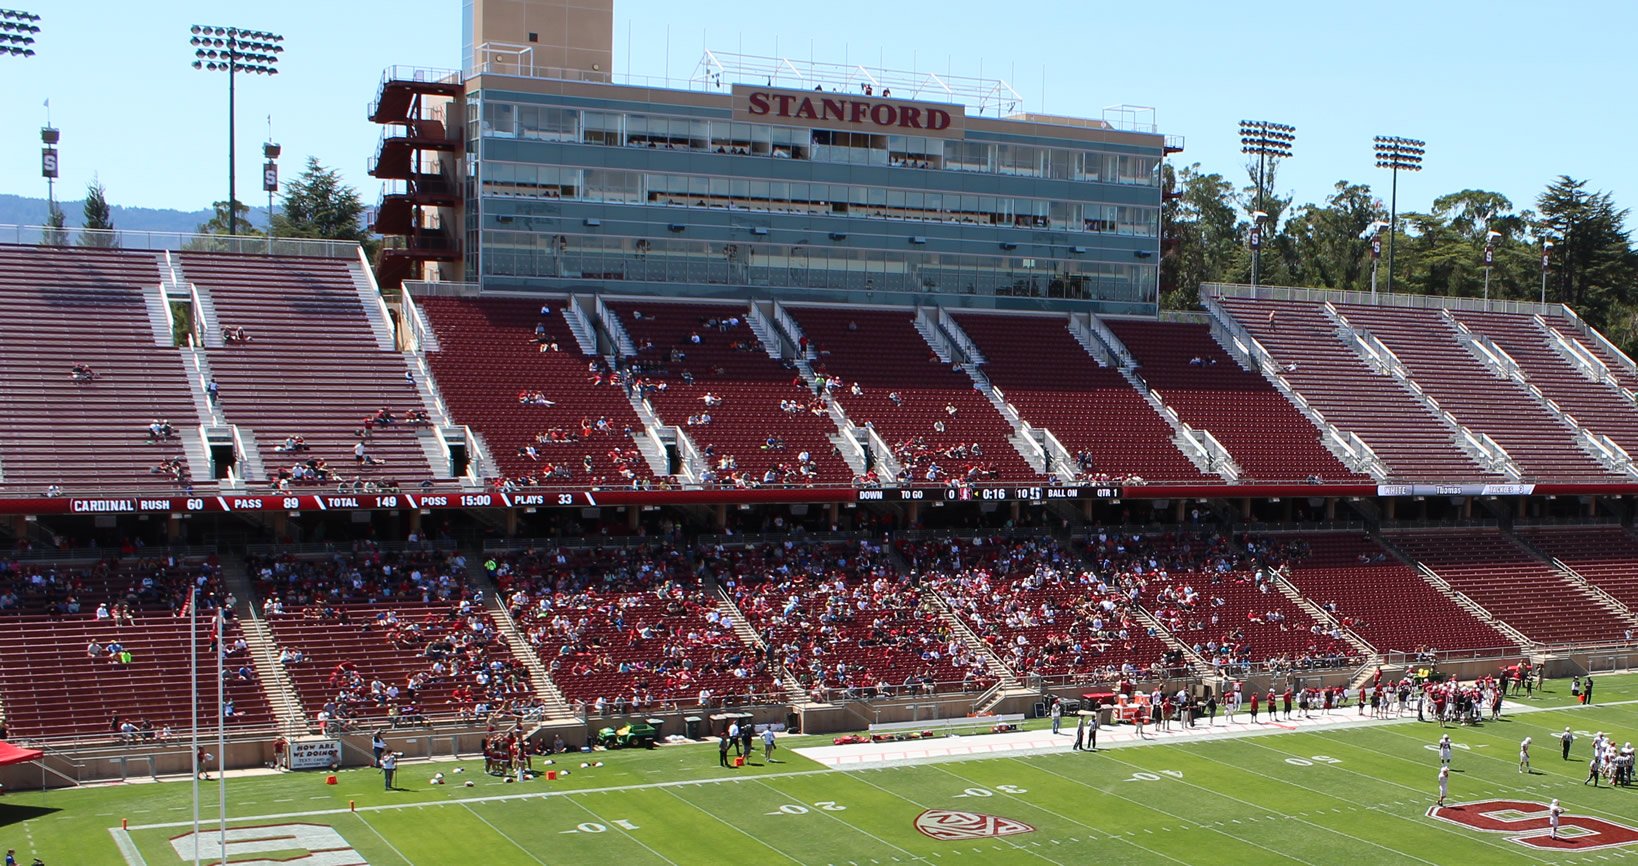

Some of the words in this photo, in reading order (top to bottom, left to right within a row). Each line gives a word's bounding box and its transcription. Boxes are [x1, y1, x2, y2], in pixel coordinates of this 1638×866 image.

[748, 91, 951, 131] STANFORD
[44, 155, 56, 171] S
[265, 169, 276, 186] S
[859, 490, 883, 500] DOWN
[901, 490, 911, 500] TO
[912, 490, 923, 499] GO
[948, 490, 955, 499] 0
[983, 489, 1005, 500] 0:16
[1017, 489, 1028, 499] 10
[1048, 488, 1065, 498] BALL
[1066, 488, 1078, 498] ON
[1097, 488, 1111, 497] QTR
[1113, 488, 1118, 497] 1
[1385, 486, 1407, 495] WHITE
[1436, 485, 1462, 494] Thomas
[1518, 485, 1525, 494] 3
[74, 500, 134, 511] CARDINAL
[141, 500, 170, 510] RUSH
[187, 499, 203, 510] 60
[234, 499, 262, 509] PASS
[283, 497, 299, 508] 89
[328, 497, 359, 507] TOTAL
[375, 496, 397, 507] 149
[421, 496, 447, 506] POSS
[460, 495, 491, 506] 15:00
[514, 495, 544, 505] PLAYS
[558, 494, 572, 505] 33
[1284, 755, 1343, 767] 50
[1132, 769, 1184, 782] 40
[964, 784, 1028, 797] 30
[779, 801, 847, 815] 20
[577, 818, 640, 834] 10
